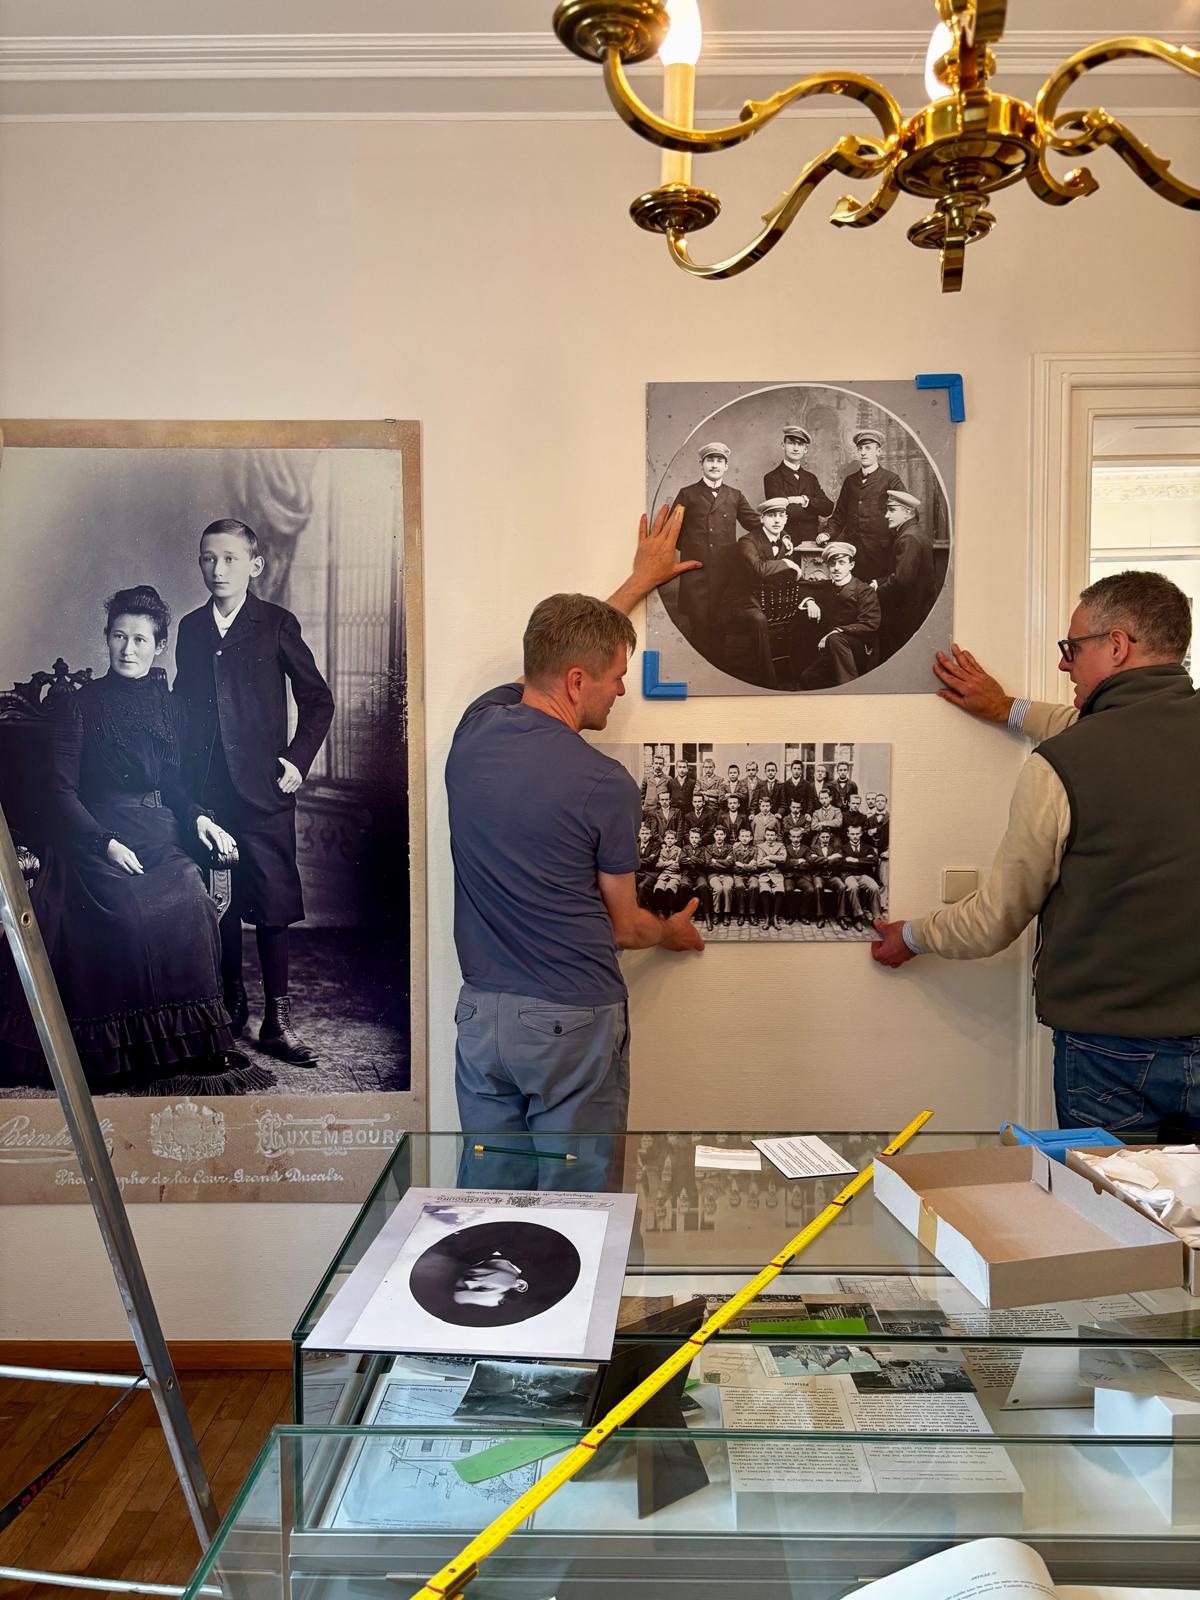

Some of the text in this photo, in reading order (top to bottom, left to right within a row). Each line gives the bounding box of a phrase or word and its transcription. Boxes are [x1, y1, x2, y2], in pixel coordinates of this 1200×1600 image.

[55, 1168, 148, 1192] Phophe
[151, 1171, 171, 1185] de
[230, 1168, 283, 1184] Grand
